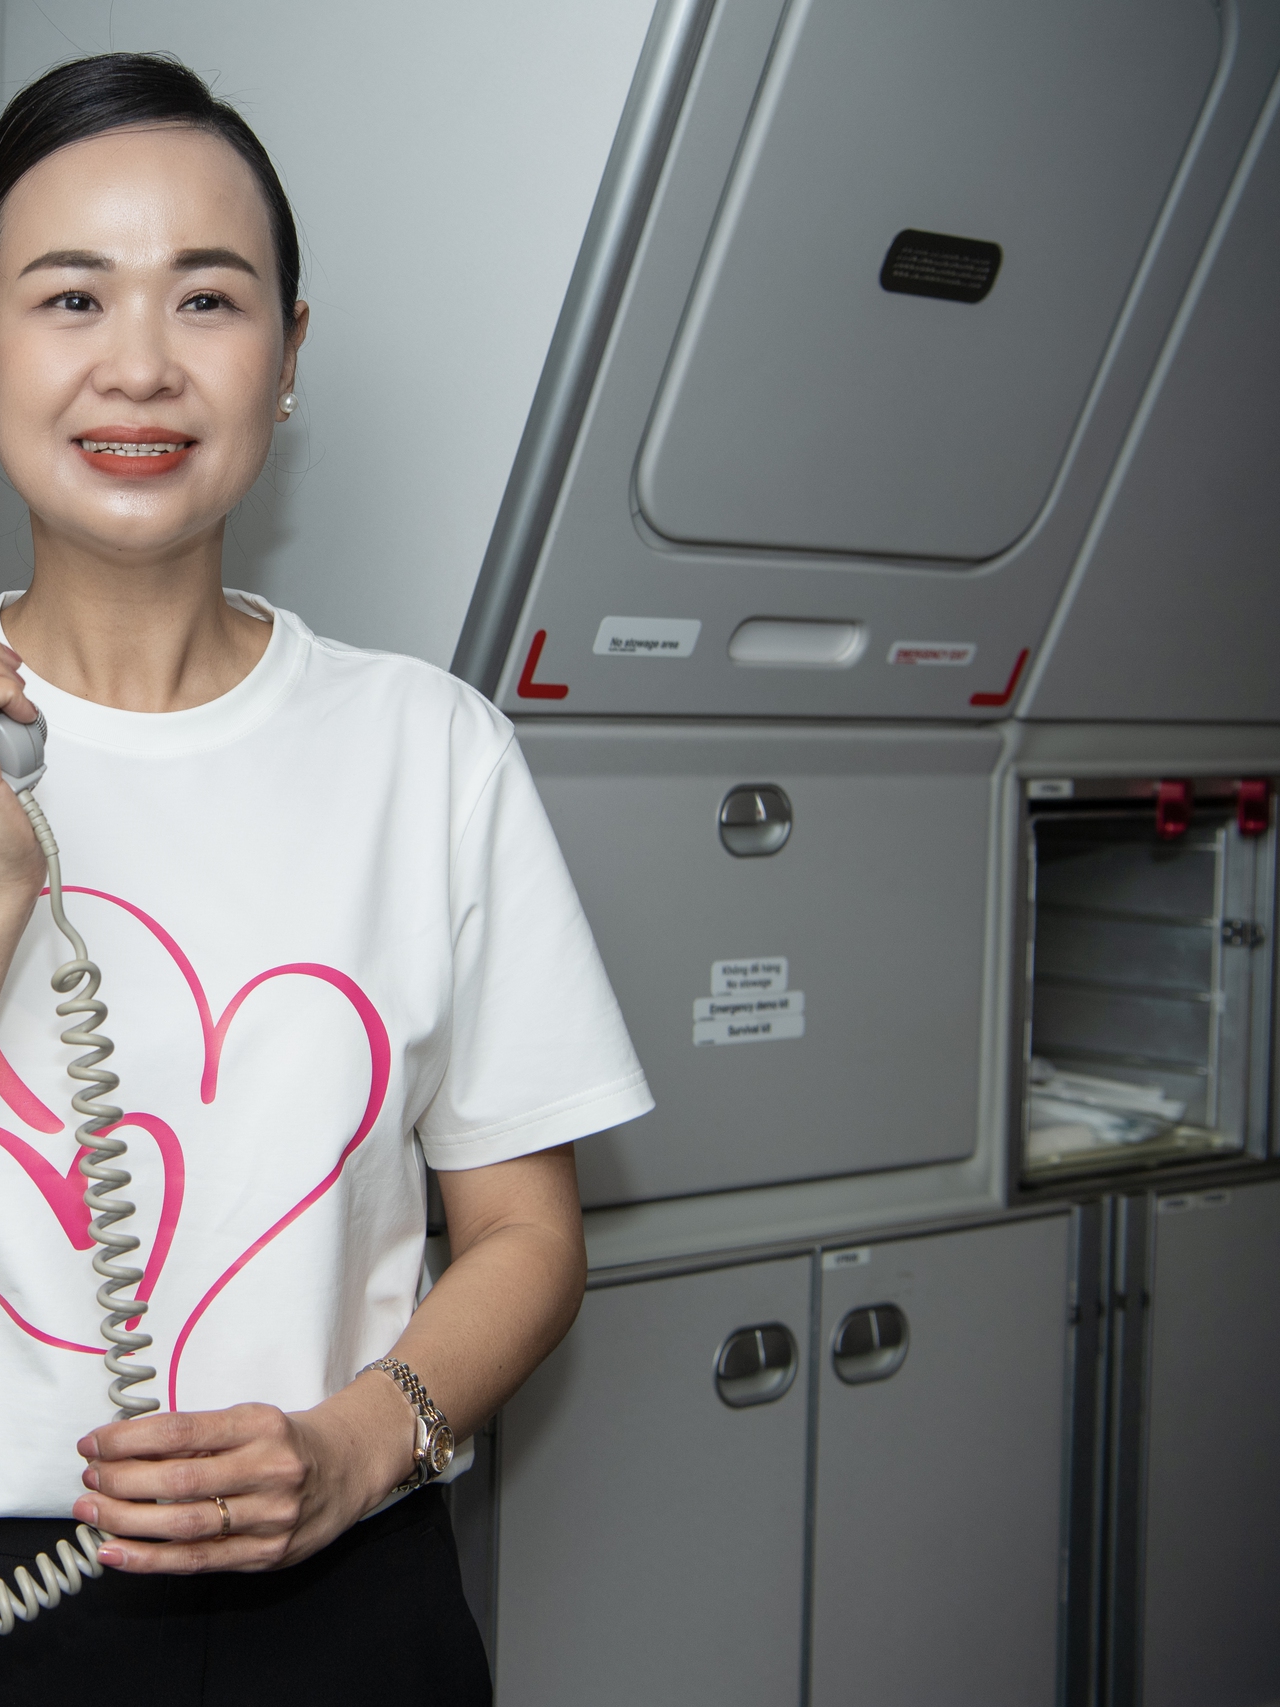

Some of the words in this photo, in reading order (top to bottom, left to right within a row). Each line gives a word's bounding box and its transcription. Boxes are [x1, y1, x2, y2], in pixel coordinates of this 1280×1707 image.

[610, 637, 622, 647] No
[624, 638, 659, 650] stowage
[660, 641, 679, 649] area
[897, 648, 949, 660] EMERGENCY
[949, 649, 969, 660] EXIT
[726, 980, 737, 988] No
[709, 1002, 754, 1015] Emergency
[756, 999, 777, 1011] demo
[778, 998, 789, 1008] kit
[728, 1023, 759, 1036] Survival
[761, 1022, 771, 1034] kit
